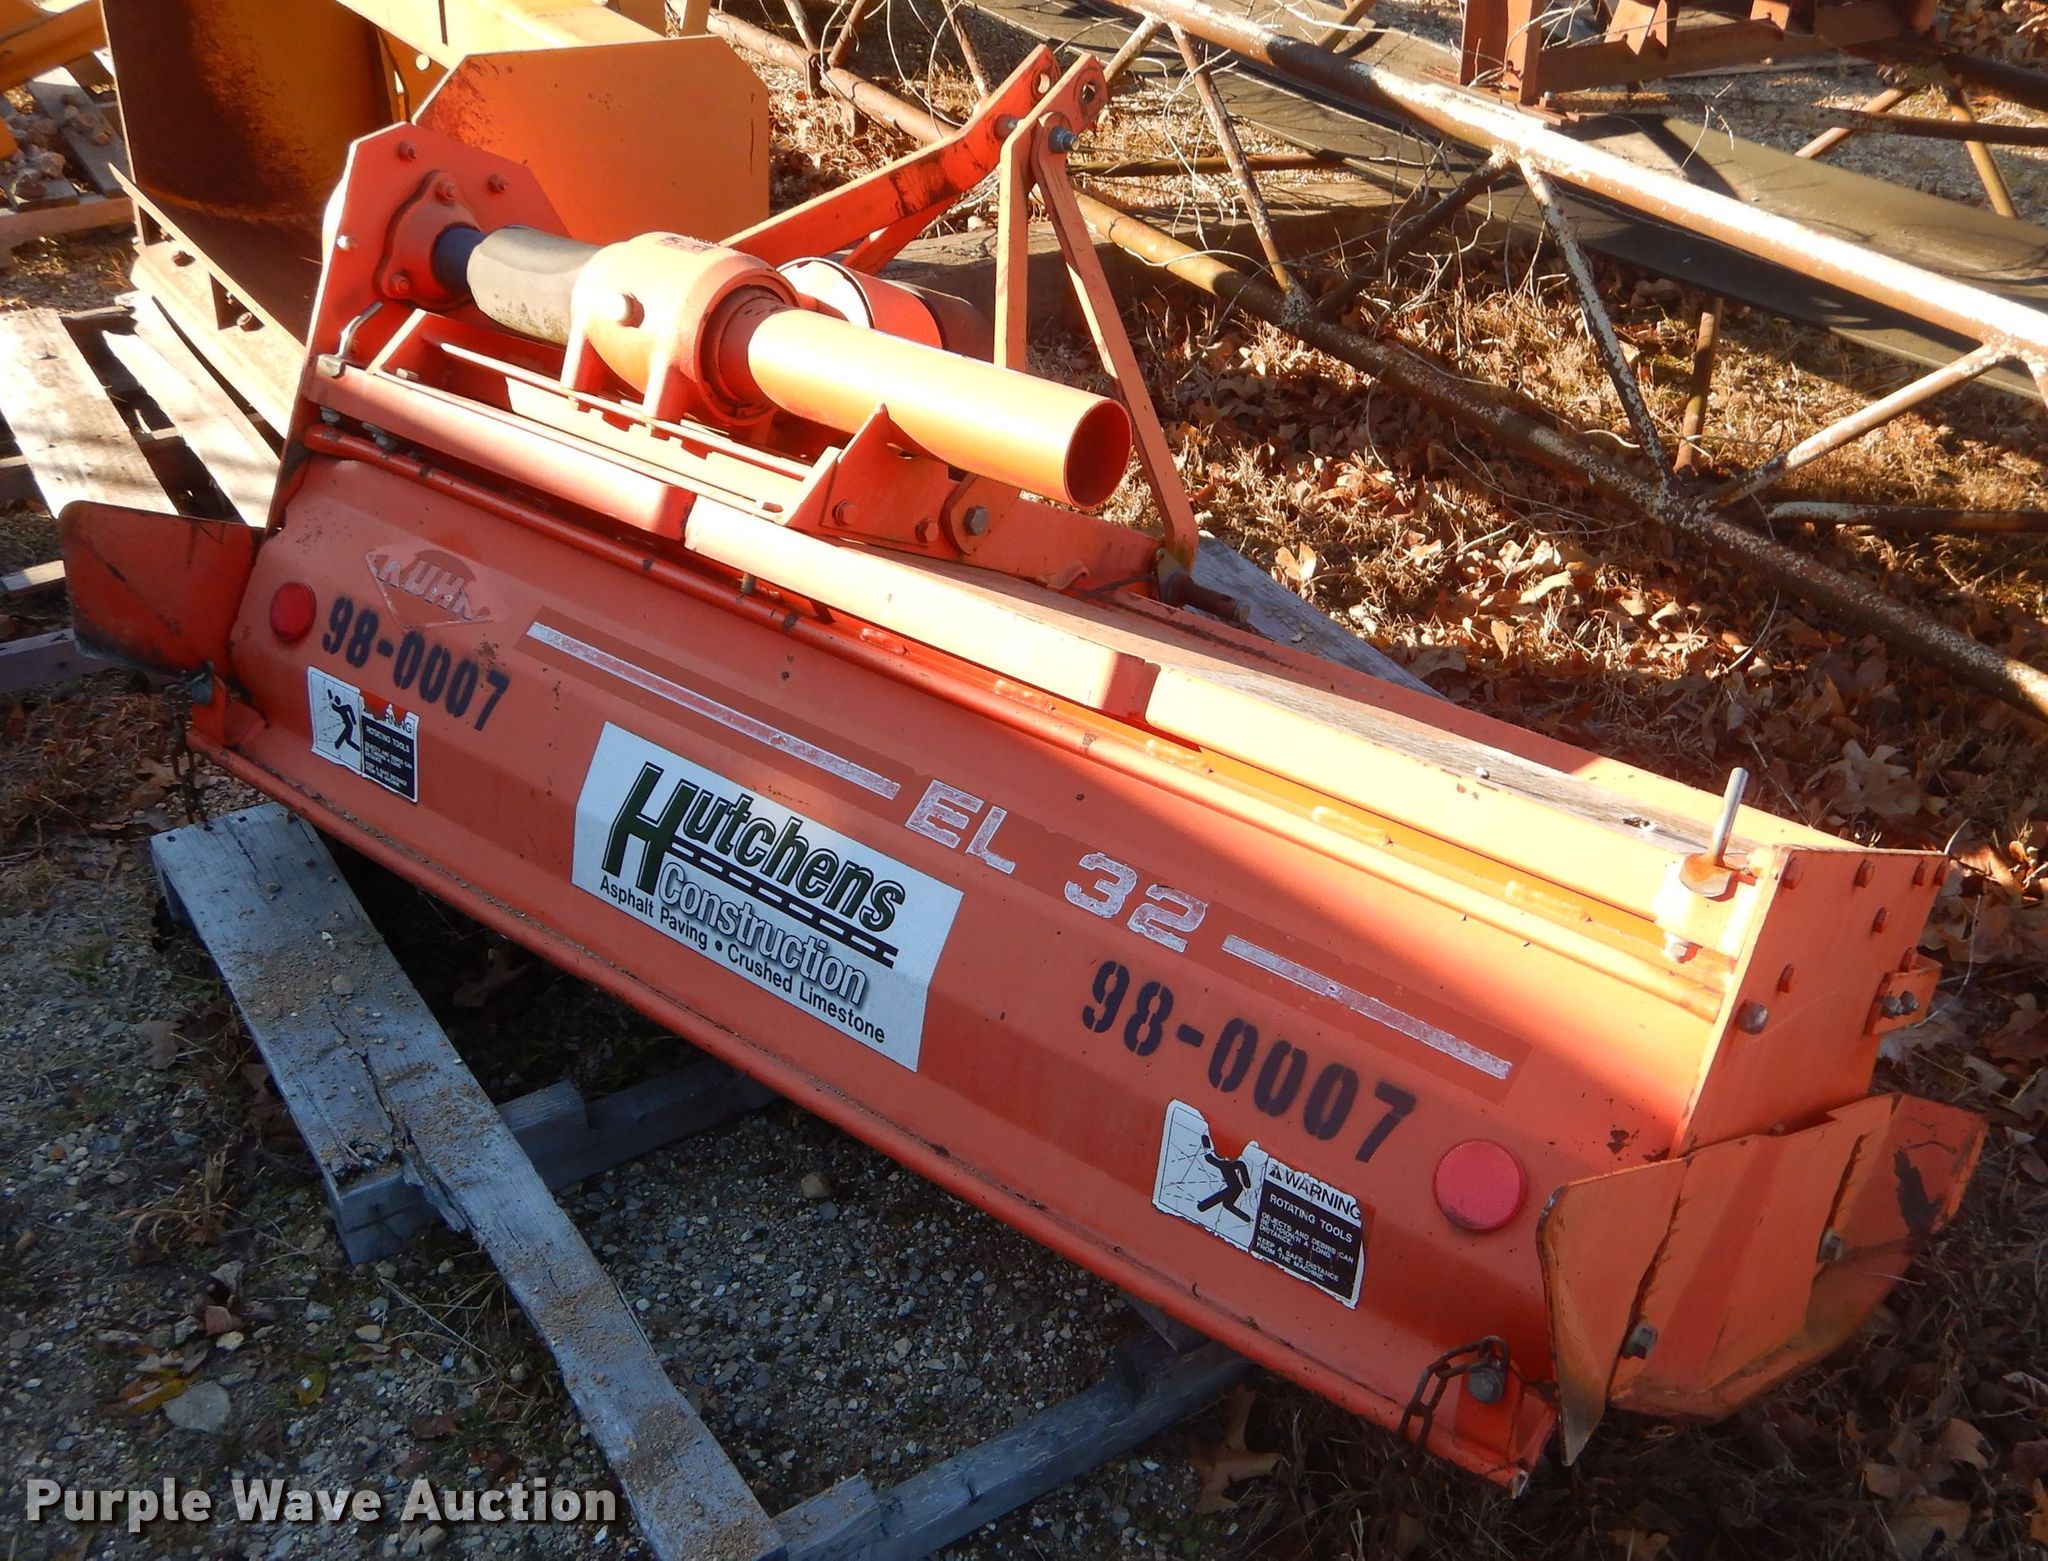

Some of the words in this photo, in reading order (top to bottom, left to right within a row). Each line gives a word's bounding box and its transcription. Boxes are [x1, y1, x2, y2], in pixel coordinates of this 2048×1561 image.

[322, 596, 511, 732] 98-0007
[602, 761, 906, 932] Hutchens
[904, 778, 1016, 875] EL
[1064, 852, 1208, 953] 32
[600, 875, 654, 919] Asphalt
[660, 909, 708, 950] Paving
[728, 943, 793, 994] Crushed
[799, 983, 885, 1044] Limestone
[658, 861, 869, 1006] Construction
[1082, 960, 1417, 1164] 98-0007
[1256, 1241, 1276, 1255] FROM
[1269, 1193, 1316, 1225] ROTATING
[1319, 1219, 1353, 1243] TOOLS
[1285, 1168, 1361, 1220] WARNING
[1294, 1229, 1309, 1241] AND
[1312, 1237, 1336, 1255] DEBRIS
[1338, 1251, 1354, 1264] CAN
[1305, 1260, 1340, 1282] DISTANCE
